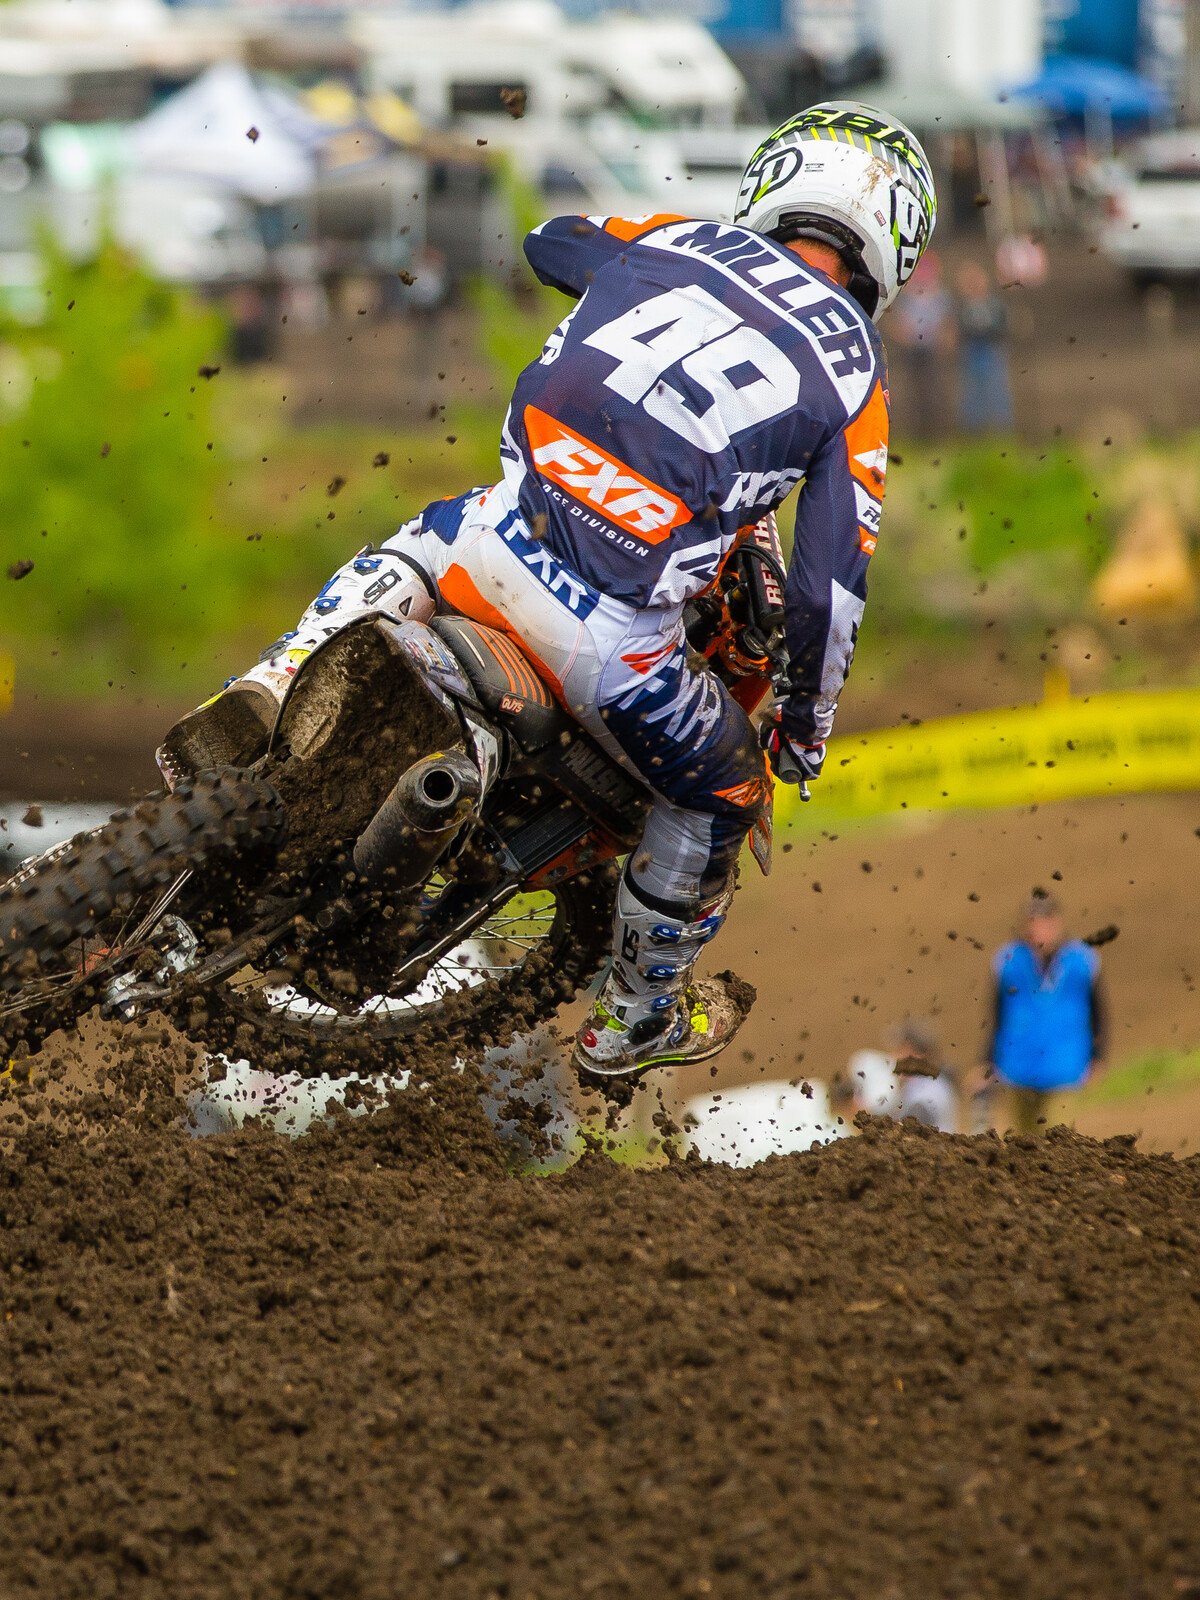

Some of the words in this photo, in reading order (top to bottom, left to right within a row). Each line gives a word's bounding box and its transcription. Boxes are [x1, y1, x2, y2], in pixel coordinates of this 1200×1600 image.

[670, 223, 872, 378] MILLER
[582, 284, 801, 454] 49
[533, 428, 678, 533] FXR
[569, 506, 649, 557] DIVISION
[502, 697, 525, 713] GUTS
